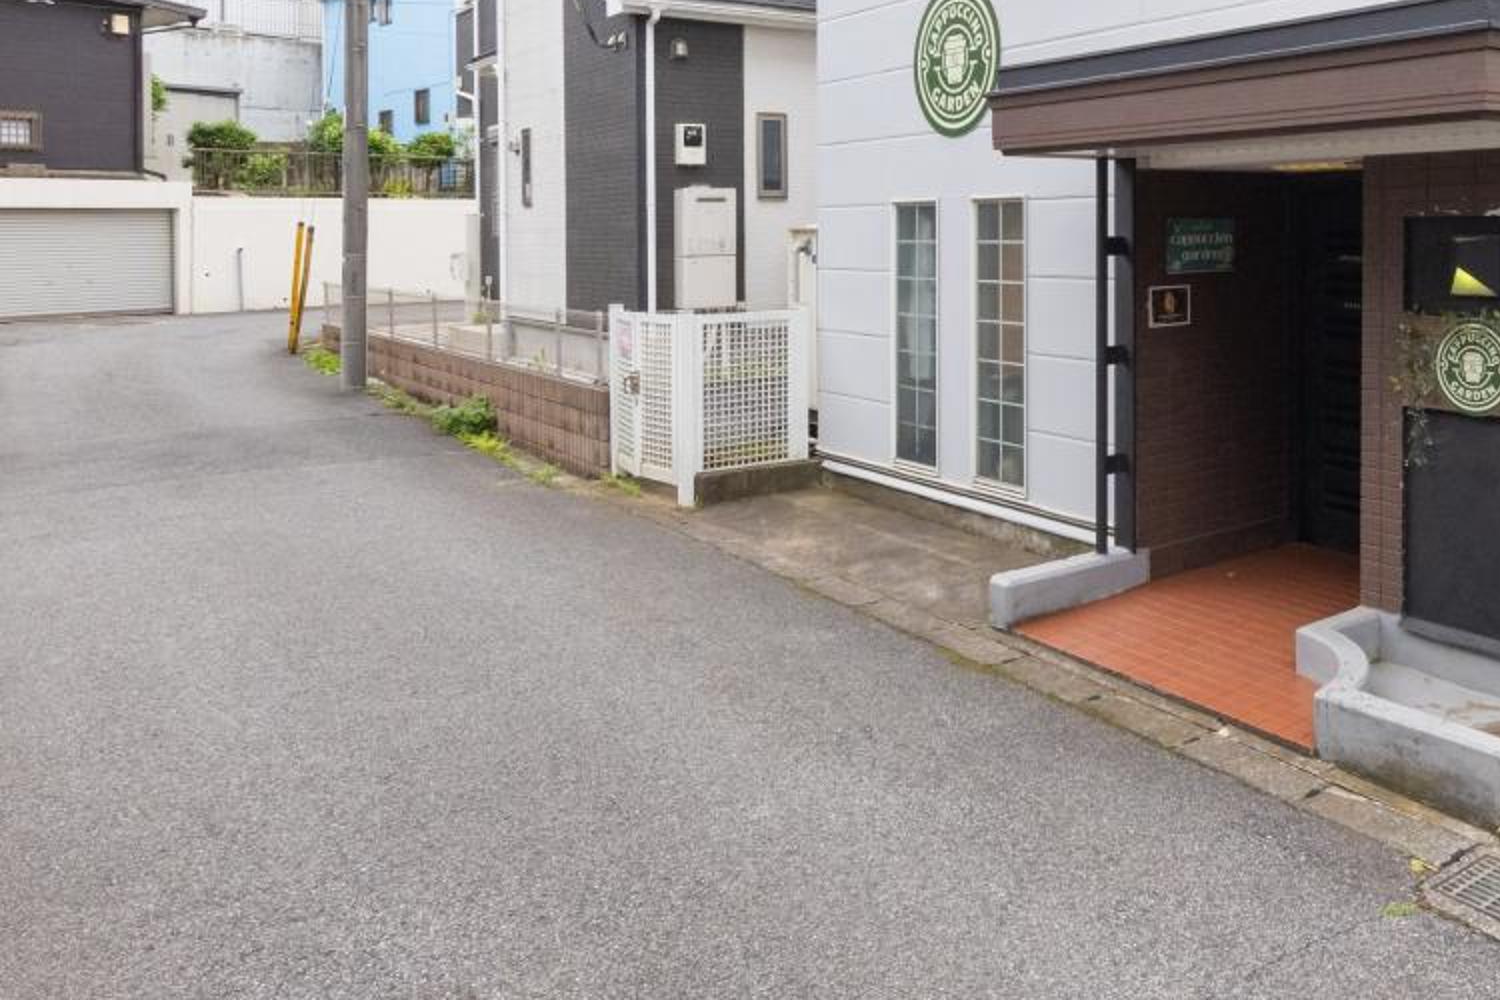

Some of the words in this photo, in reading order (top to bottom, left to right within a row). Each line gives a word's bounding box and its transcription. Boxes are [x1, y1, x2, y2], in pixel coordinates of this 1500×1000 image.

[927, 3, 983, 56] CAPPUCCINO
[931, 81, 980, 111] GARDEN
[1450, 381, 1496, 401] GARDEN
